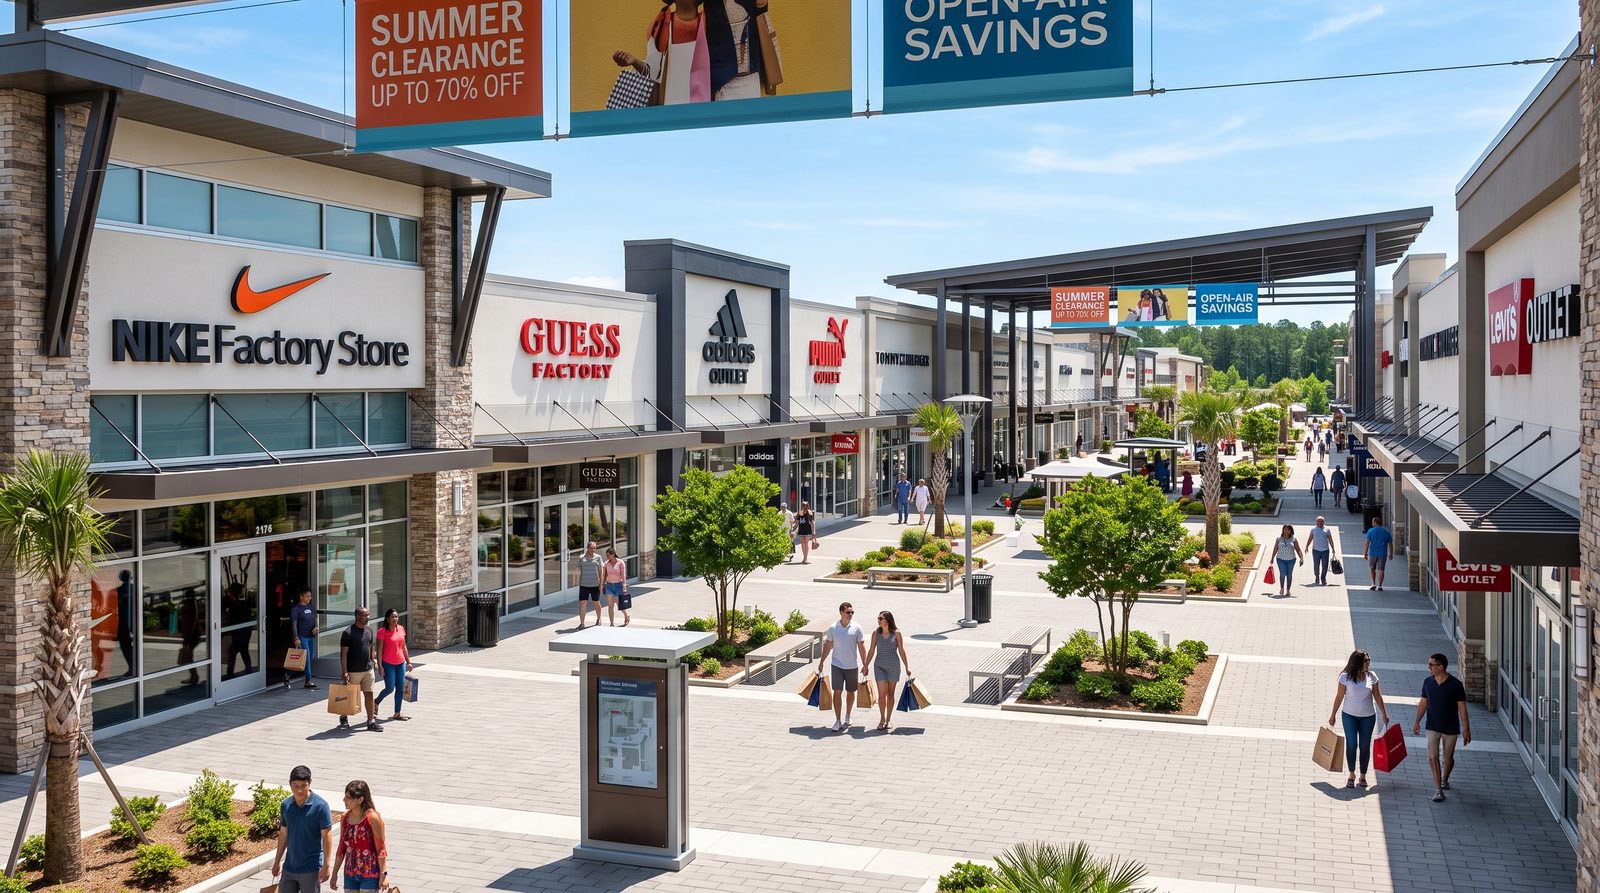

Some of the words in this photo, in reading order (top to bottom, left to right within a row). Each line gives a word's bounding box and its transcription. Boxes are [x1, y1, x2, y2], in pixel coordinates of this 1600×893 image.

[371, 1, 524, 46] SUMMER
[905, 11, 1108, 62] SAVINGS
[371, 38, 525, 78] CLEARANCE
[372, 83, 398, 108] UP
[403, 80, 429, 105] TO
[435, 75, 478, 102] 70%
[484, 71, 525, 98] OFF
[1055, 292, 1105, 301] SUMMER
[1200, 293, 1254, 303] OPEN-AIR
[1055, 302, 1105, 310] CLEARANCE
[1201, 303, 1253, 313] SAVINGS
[1066, 310, 1075, 318] TO
[1090, 310, 1105, 318] OFF
[1526, 284, 1572, 344] OUTLET
[520, 317, 621, 359] GUESS
[111, 318, 211, 364] NIKE
[214, 324, 335, 375] Factory
[338, 330, 409, 367] Store
[702, 336, 756, 364] adidas
[808, 340, 842, 367] PUMA
[532, 362, 613, 379] FACTORY
[708, 368, 749, 384] OUTLET
[813, 371, 841, 384] OUTLET
[748, 452, 775, 461] adidas
[582, 468, 617, 477] GUESS
[255, 524, 273, 535] 2176
[1445, 560, 1502, 572] Levis
[1452, 575, 1497, 584] OUTLET
